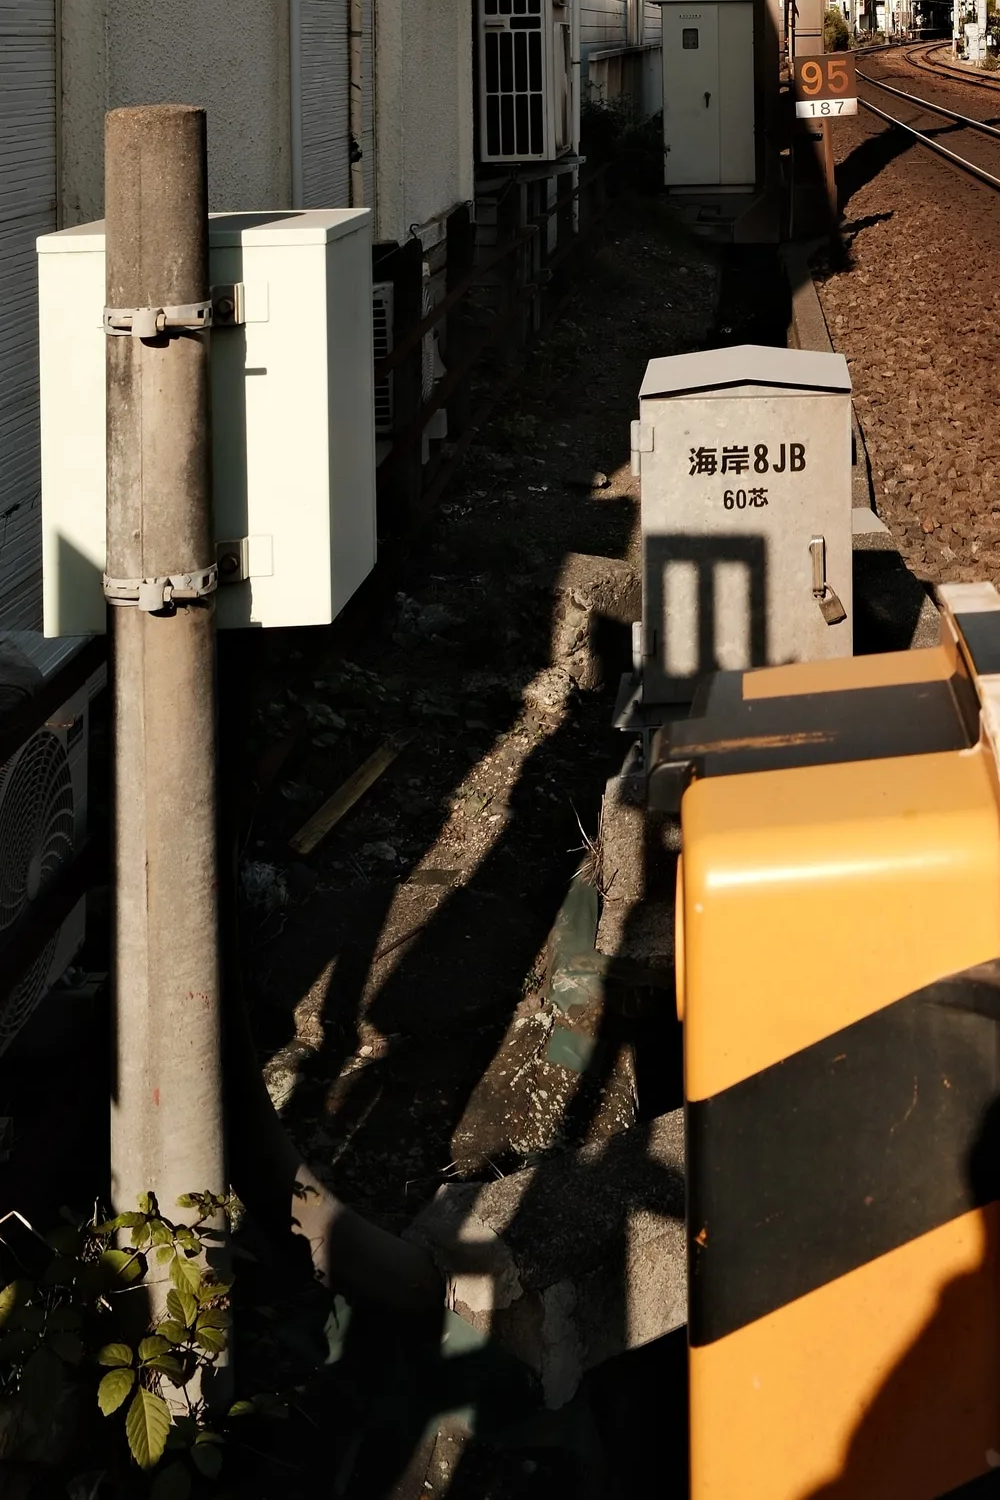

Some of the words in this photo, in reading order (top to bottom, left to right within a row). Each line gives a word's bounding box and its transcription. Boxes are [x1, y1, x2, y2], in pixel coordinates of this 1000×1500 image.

[801, 60, 849, 95] 95
[810, 101, 845, 116] 187
[688, 443, 807, 477] 海岸8JB
[723, 487, 769, 510] 60芯
